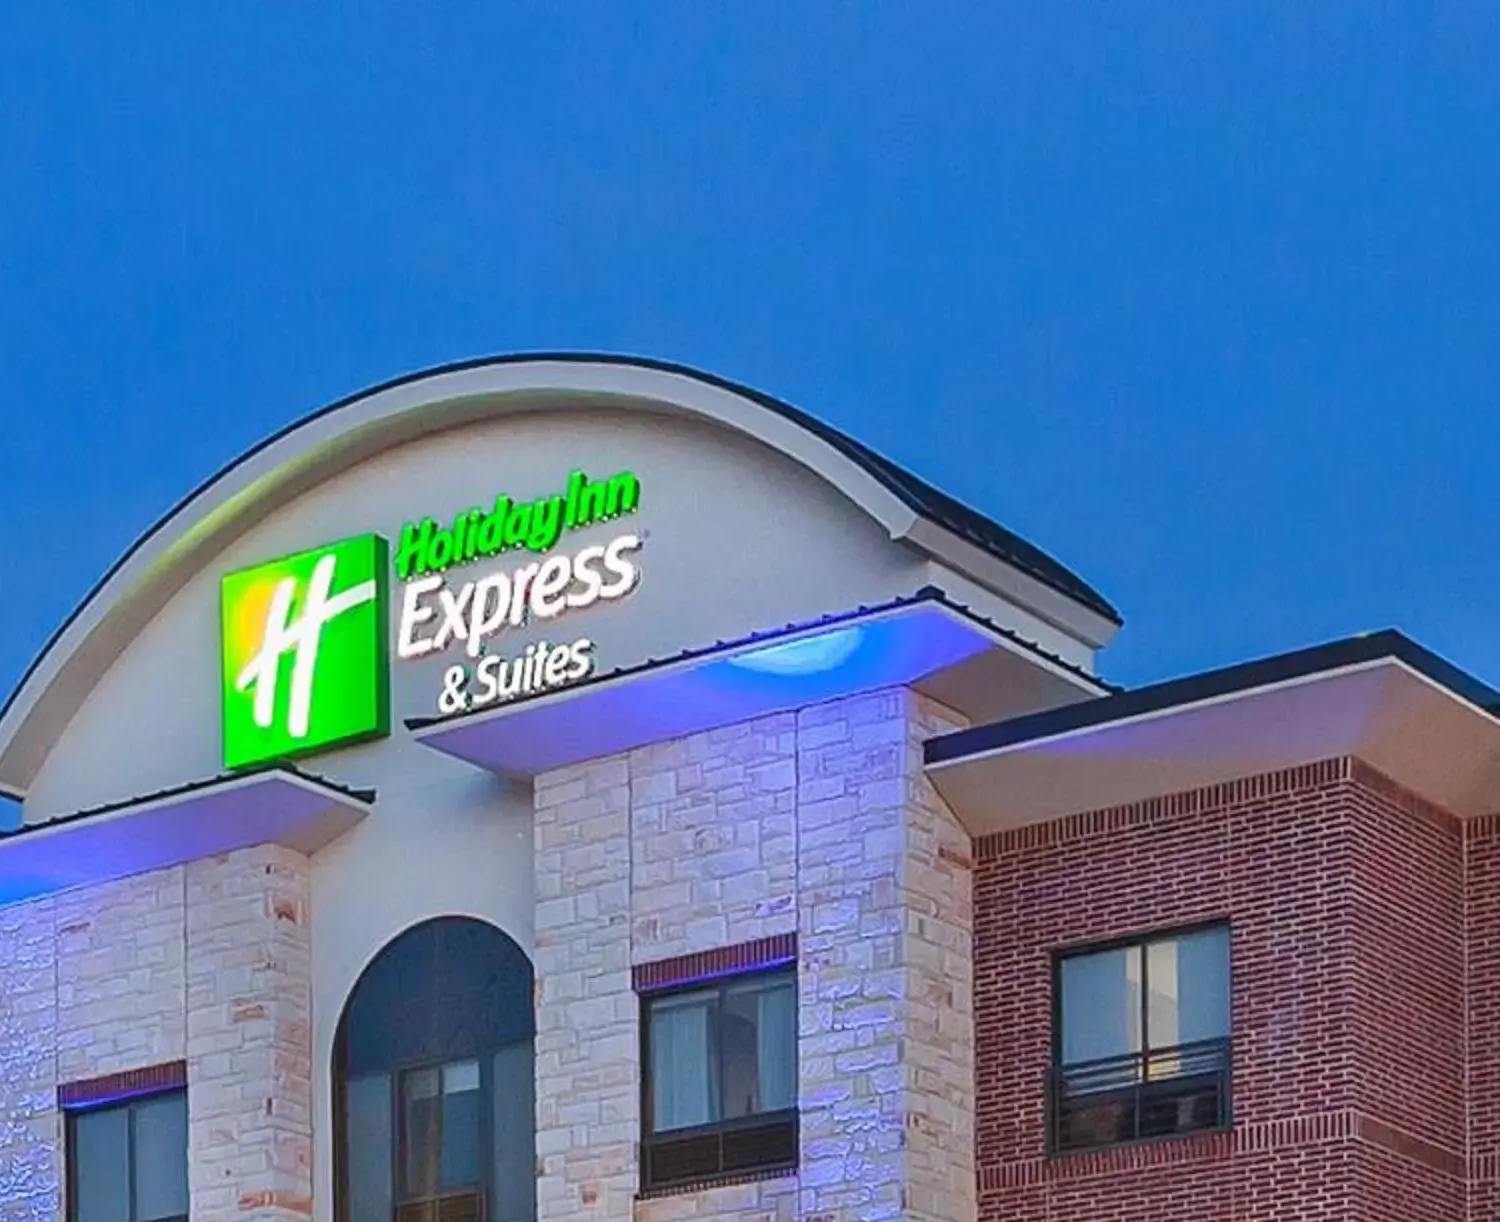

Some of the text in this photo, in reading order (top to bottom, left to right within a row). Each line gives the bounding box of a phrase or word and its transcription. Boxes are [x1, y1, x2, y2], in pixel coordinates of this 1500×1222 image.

[396, 469, 640, 579] Holiday Inn
[398, 534, 642, 658] Express
[438, 638, 594, 715] & Suites
